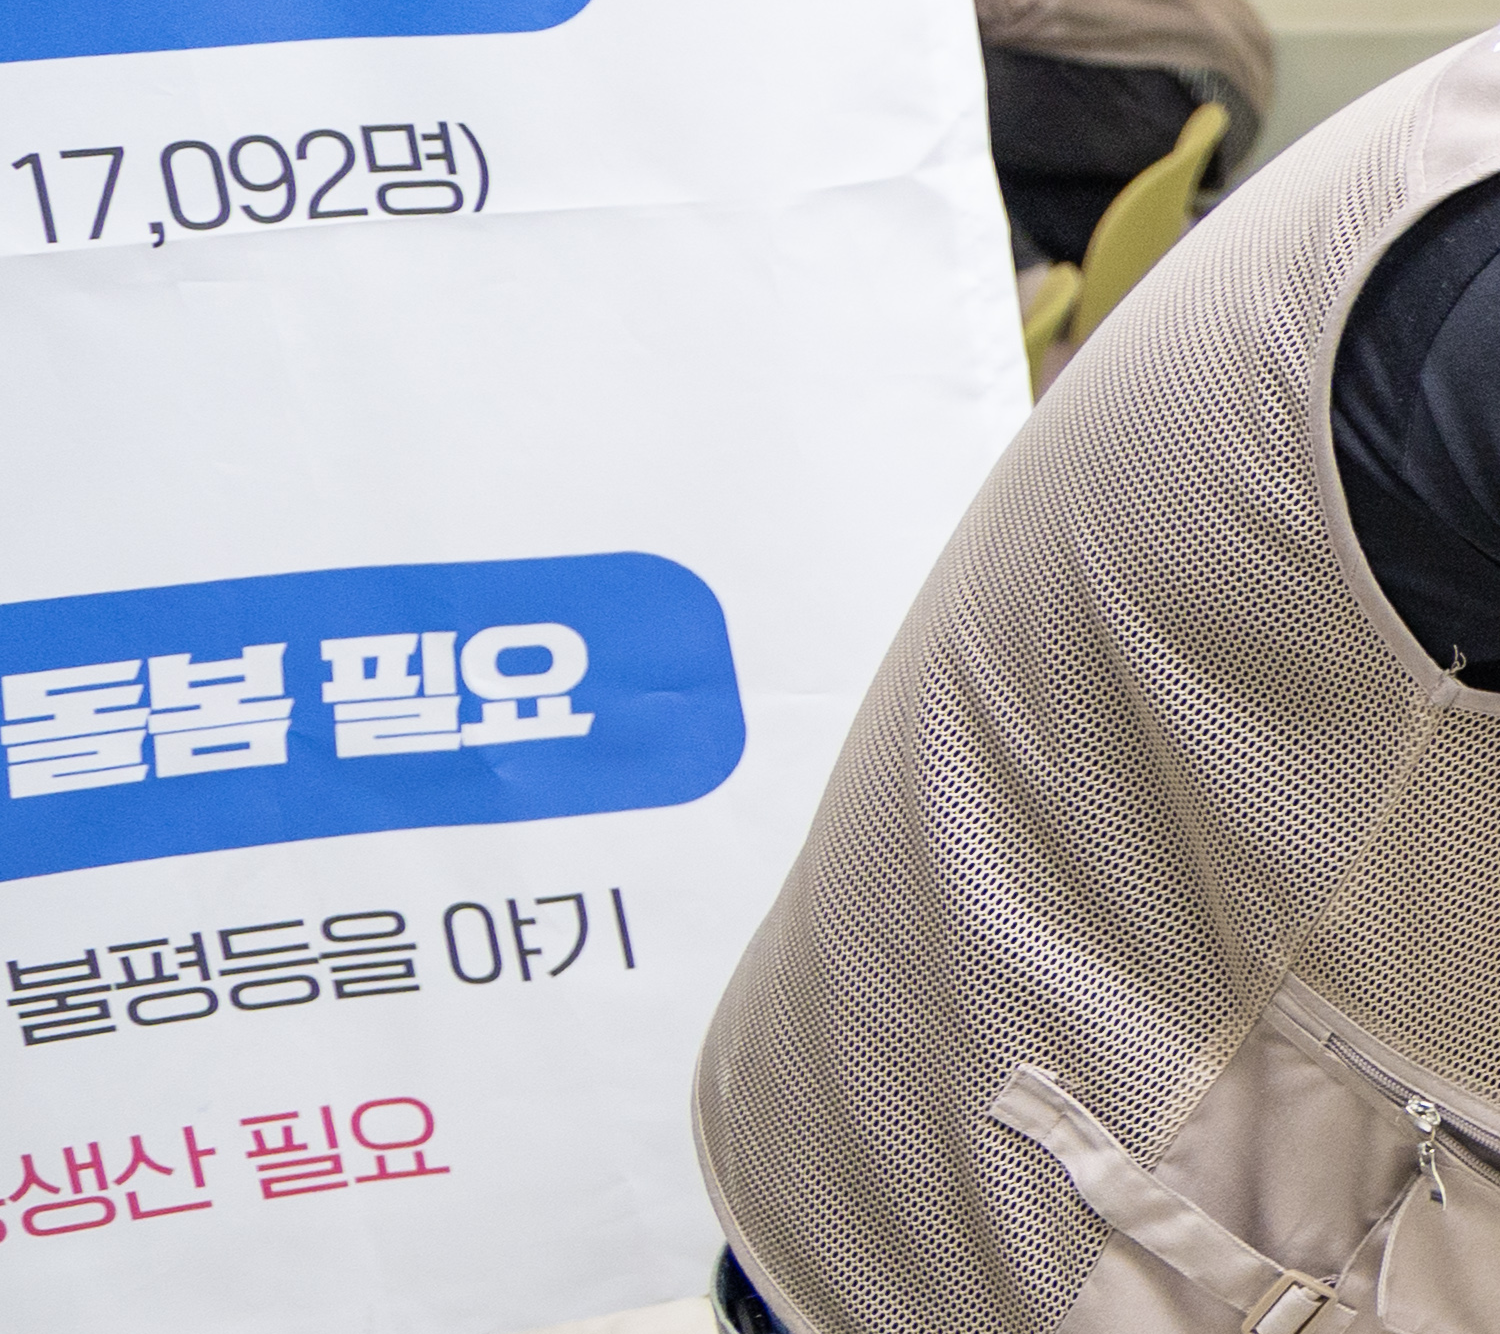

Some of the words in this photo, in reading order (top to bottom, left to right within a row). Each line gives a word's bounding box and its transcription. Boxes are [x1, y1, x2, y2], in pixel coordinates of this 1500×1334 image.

[11, 121, 490, 248] 17,092명)
[0, 642, 294, 800] 돌봄
[321, 622, 596, 759] 필요
[5, 910, 421, 1047] 불평등을
[443, 887, 637, 986] 야기
[0, 1125, 216, 1245] 생산
[240, 1097, 451, 1201] 필요
